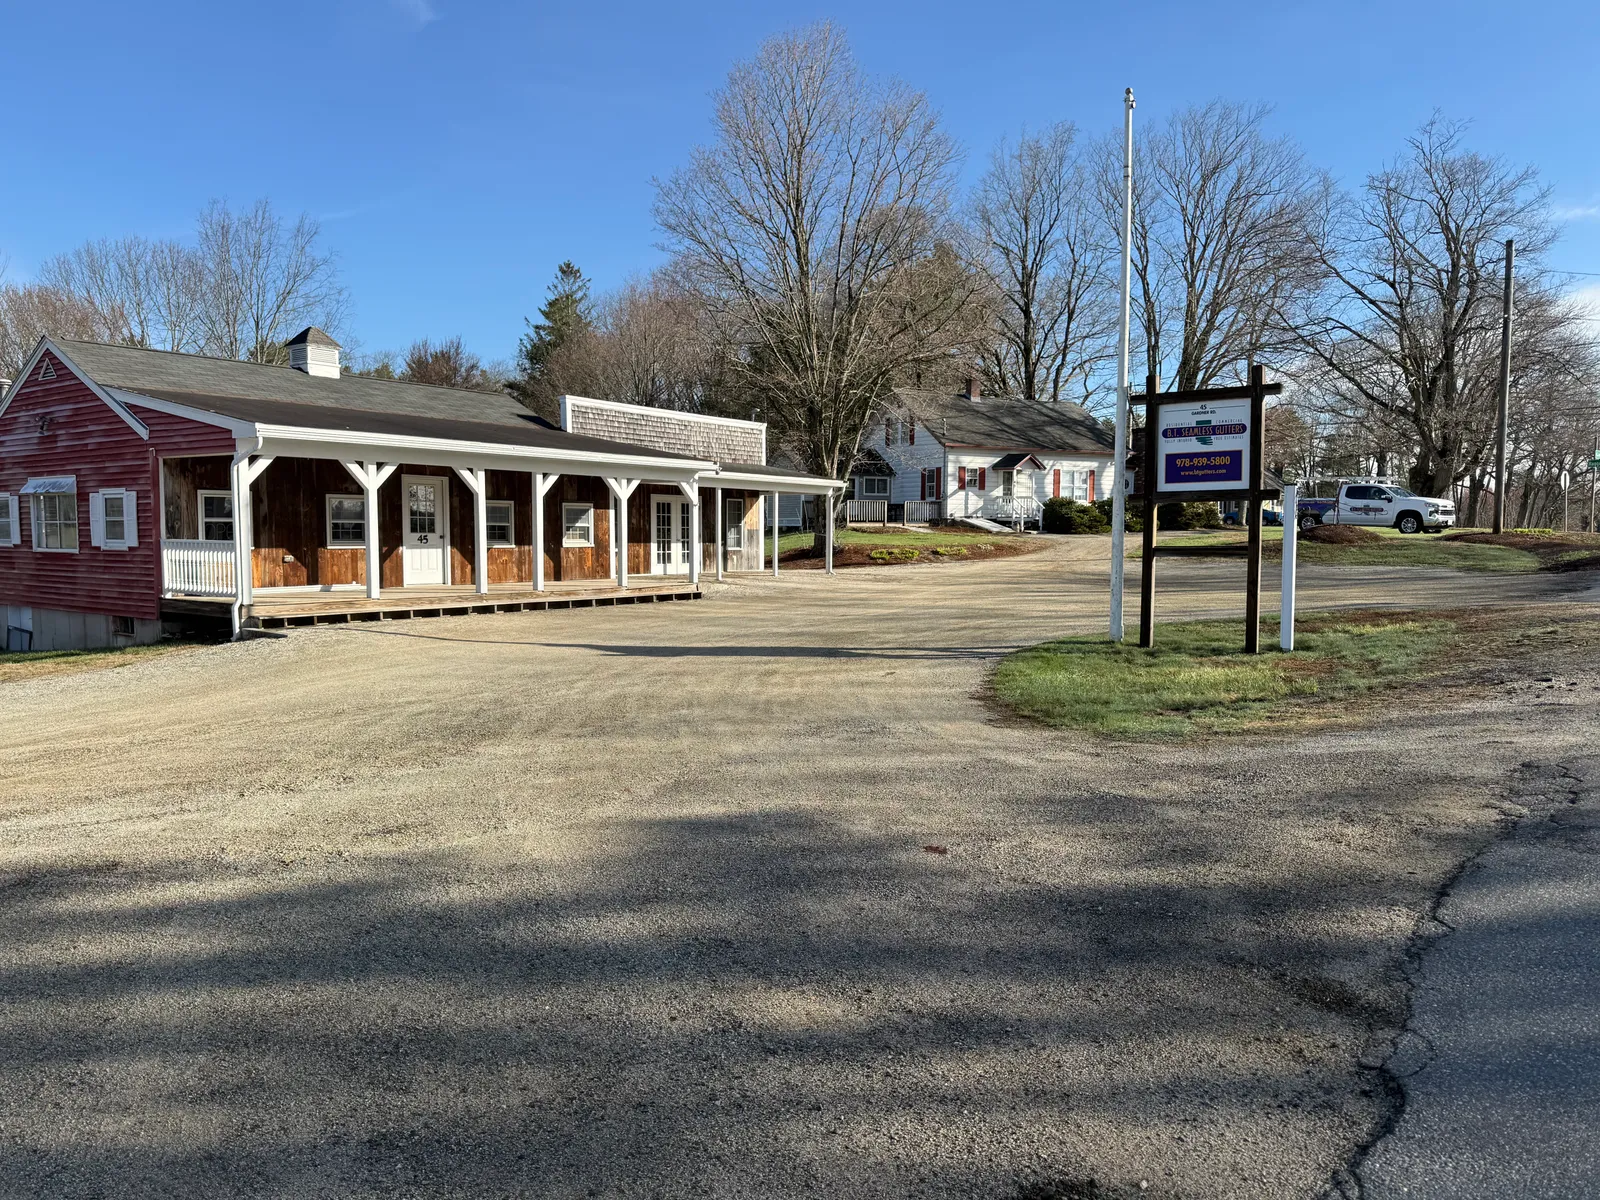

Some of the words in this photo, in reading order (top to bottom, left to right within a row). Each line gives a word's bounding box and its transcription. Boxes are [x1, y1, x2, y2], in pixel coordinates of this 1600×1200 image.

[1181, 426, 1213, 437] SEAMLESS
[1215, 424, 1243, 435] GUTTERS
[1176, 456, 1231, 467] 978-939-5800
[417, 534, 428, 544] 45
